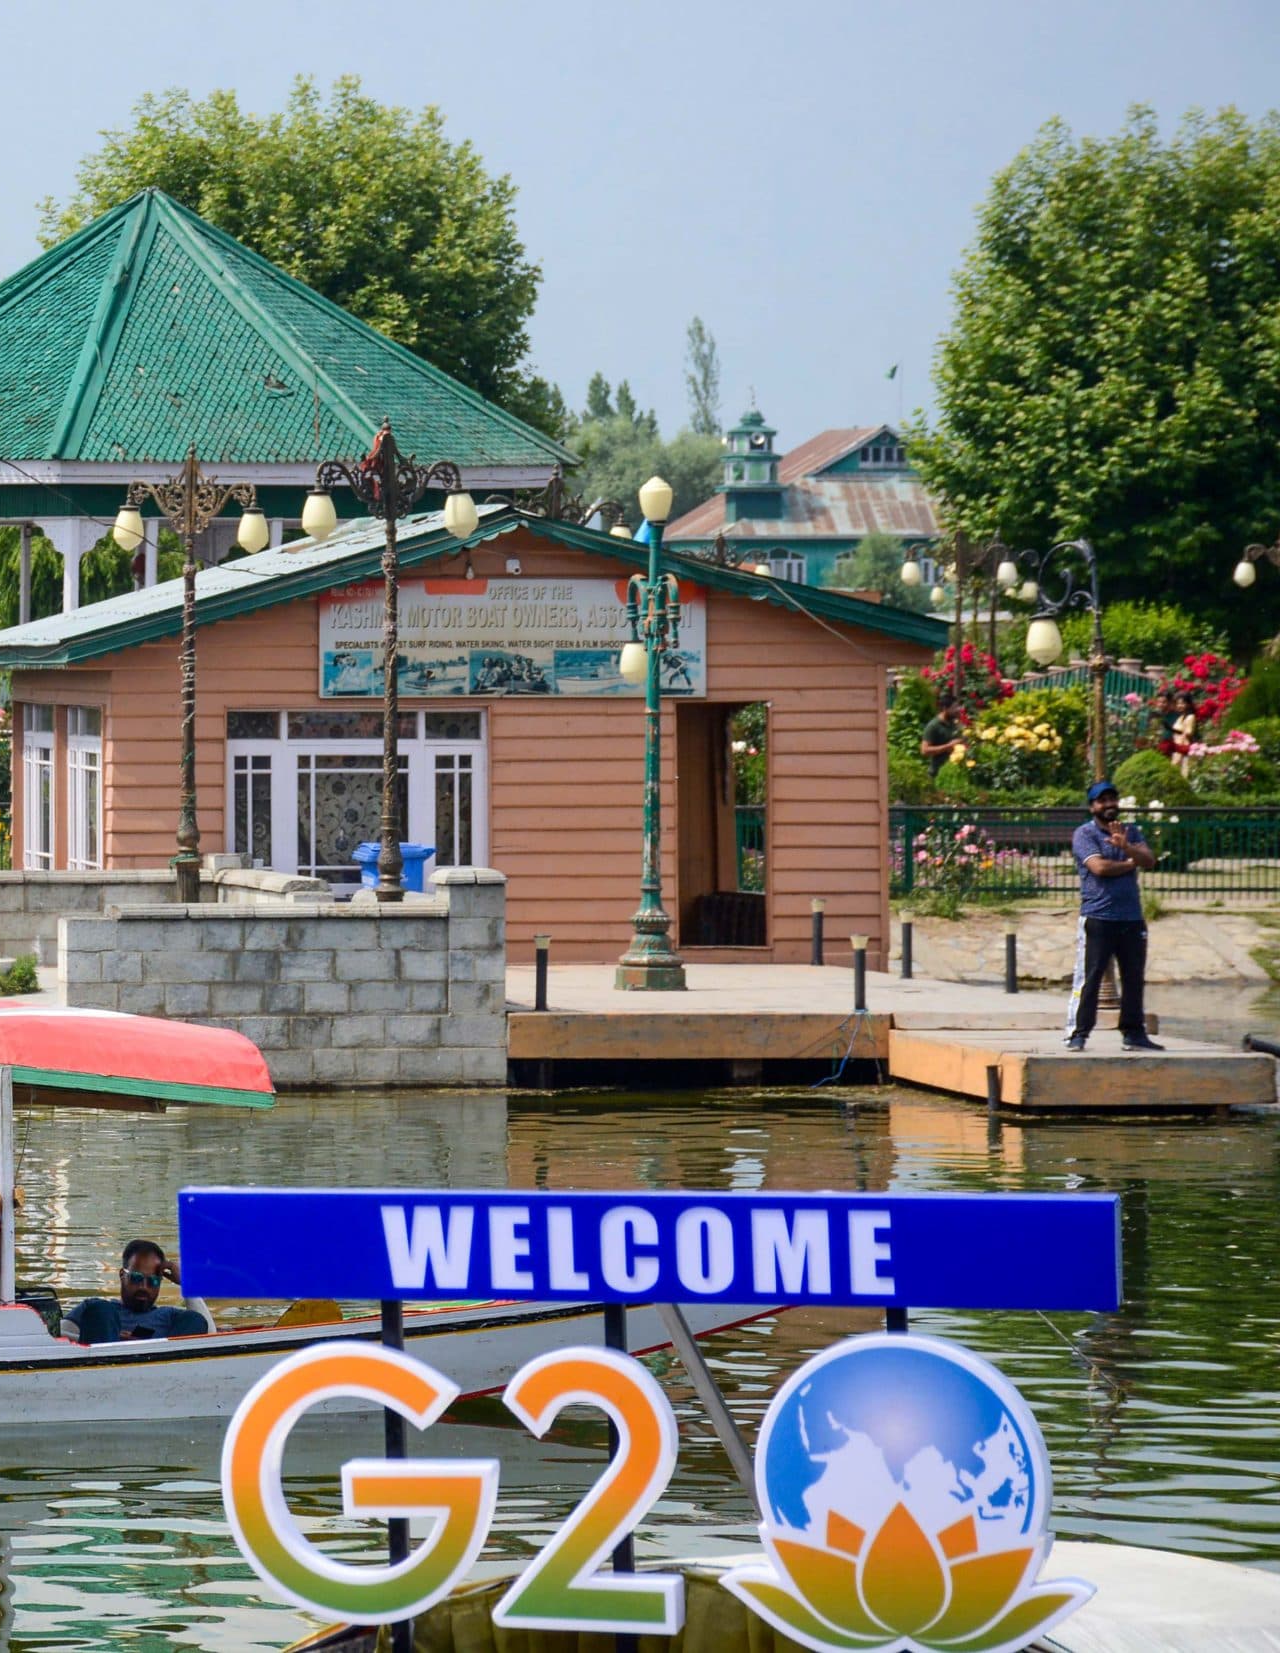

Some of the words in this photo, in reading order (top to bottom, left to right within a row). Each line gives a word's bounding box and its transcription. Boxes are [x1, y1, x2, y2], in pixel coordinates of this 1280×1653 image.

[489, 585, 529, 600] OFFICE
[532, 585, 547, 600] OF
[552, 585, 574, 600] THE
[408, 603, 462, 629] MOTOR
[466, 604, 508, 629] BOAT
[335, 640, 379, 649] SPECIALISTS
[455, 640, 479, 649] WATER
[508, 640, 534, 649] WATER
[534, 640, 554, 649] SIGHT
[555, 640, 574, 649] SEEN
[582, 640, 599, 649] FILM
[380, 1205, 897, 1295] WELCOME
